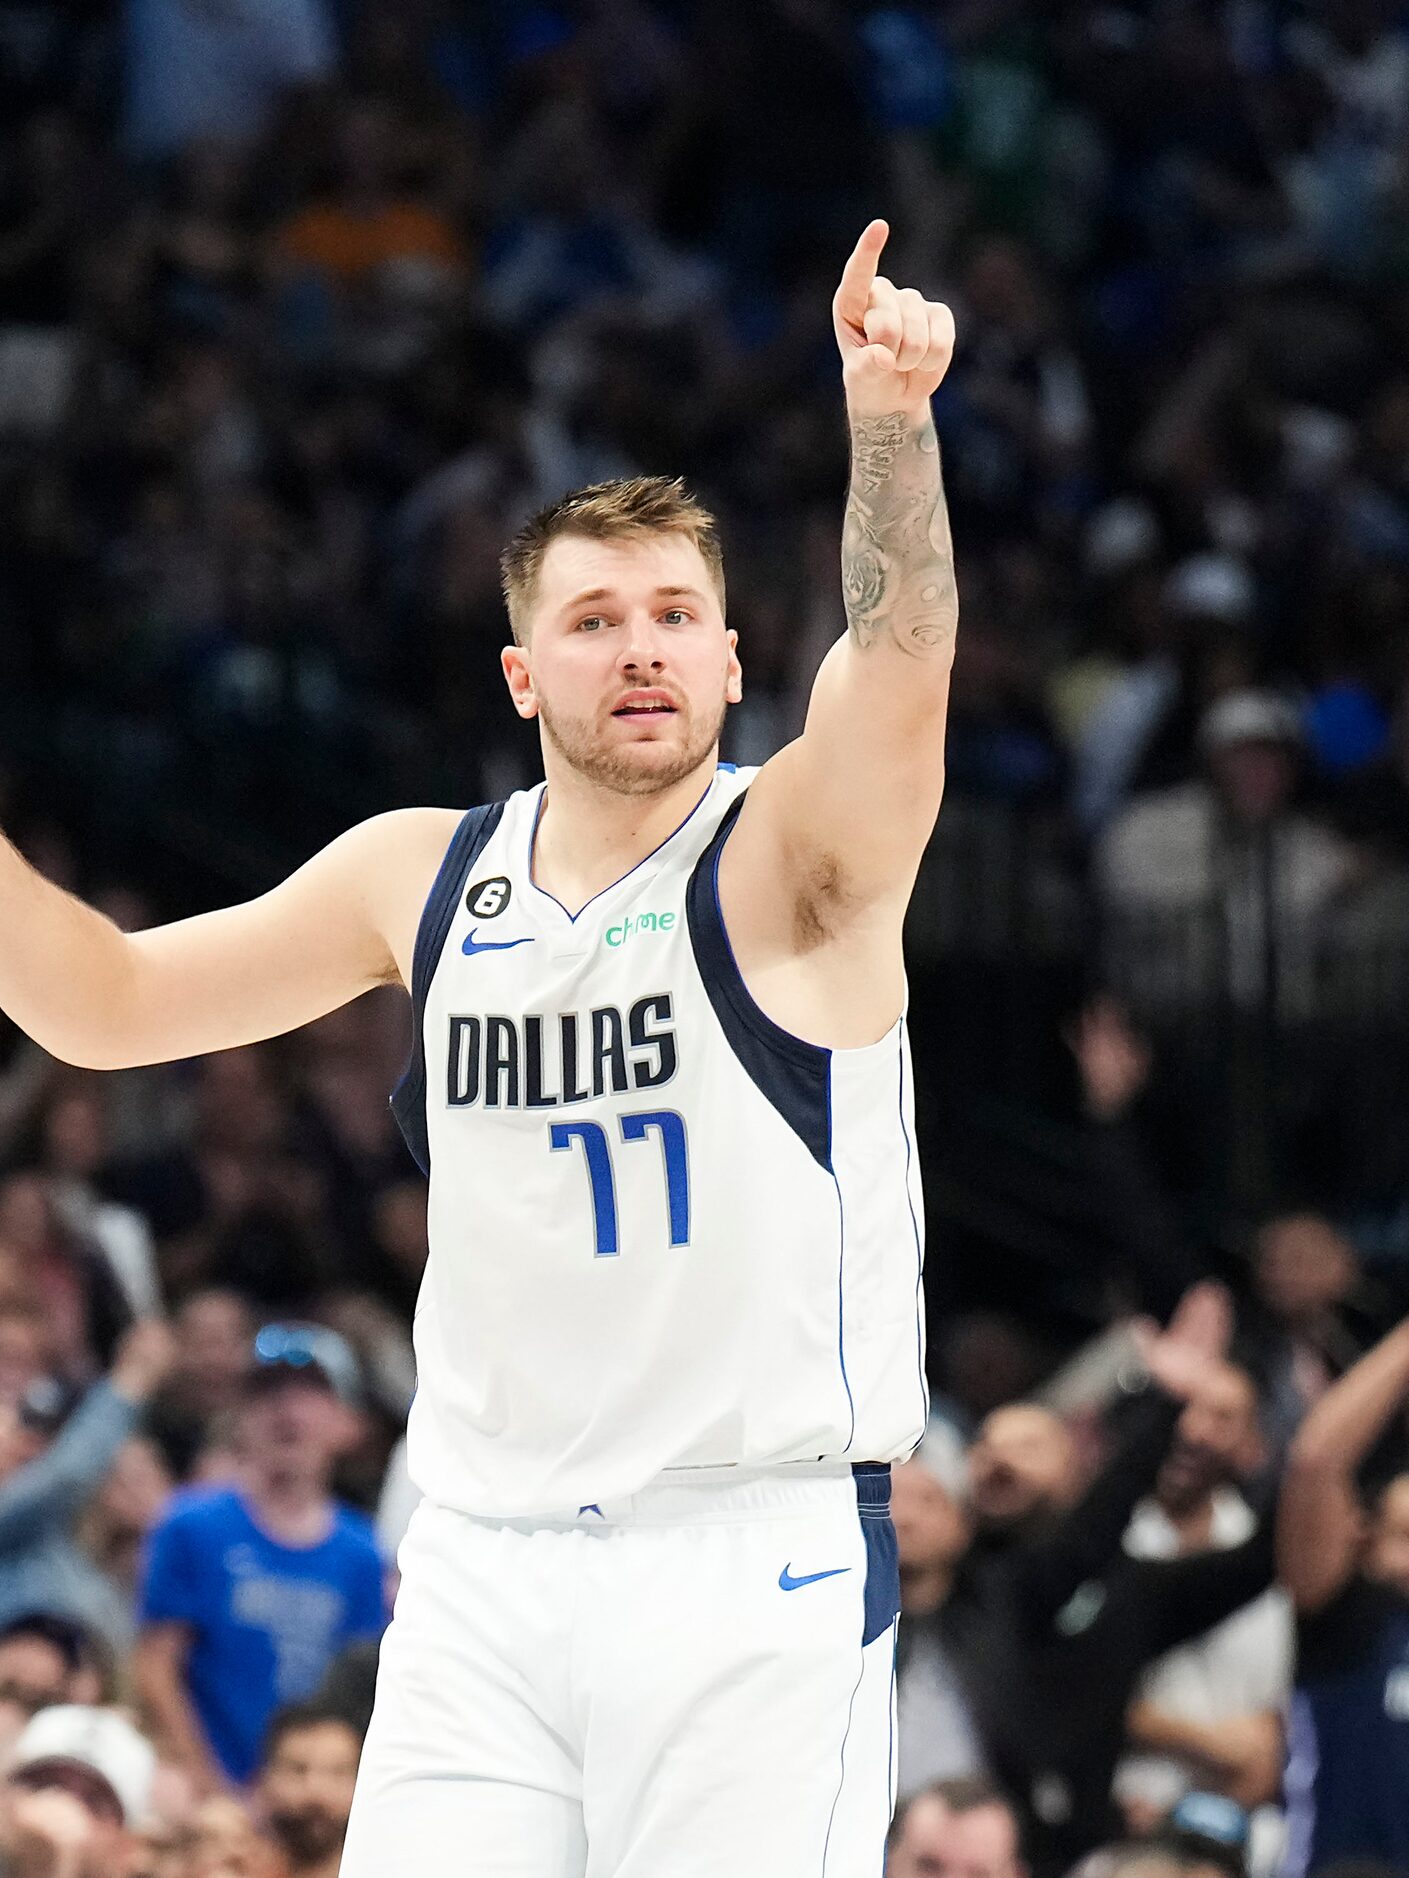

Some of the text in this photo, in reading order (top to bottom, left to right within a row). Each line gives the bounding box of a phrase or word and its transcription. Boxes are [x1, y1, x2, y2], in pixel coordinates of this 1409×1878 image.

[473, 881, 507, 915] 6
[605, 911, 676, 947] chme
[445, 991, 680, 1110] DALLAS
[548, 1107, 690, 1258] 77
